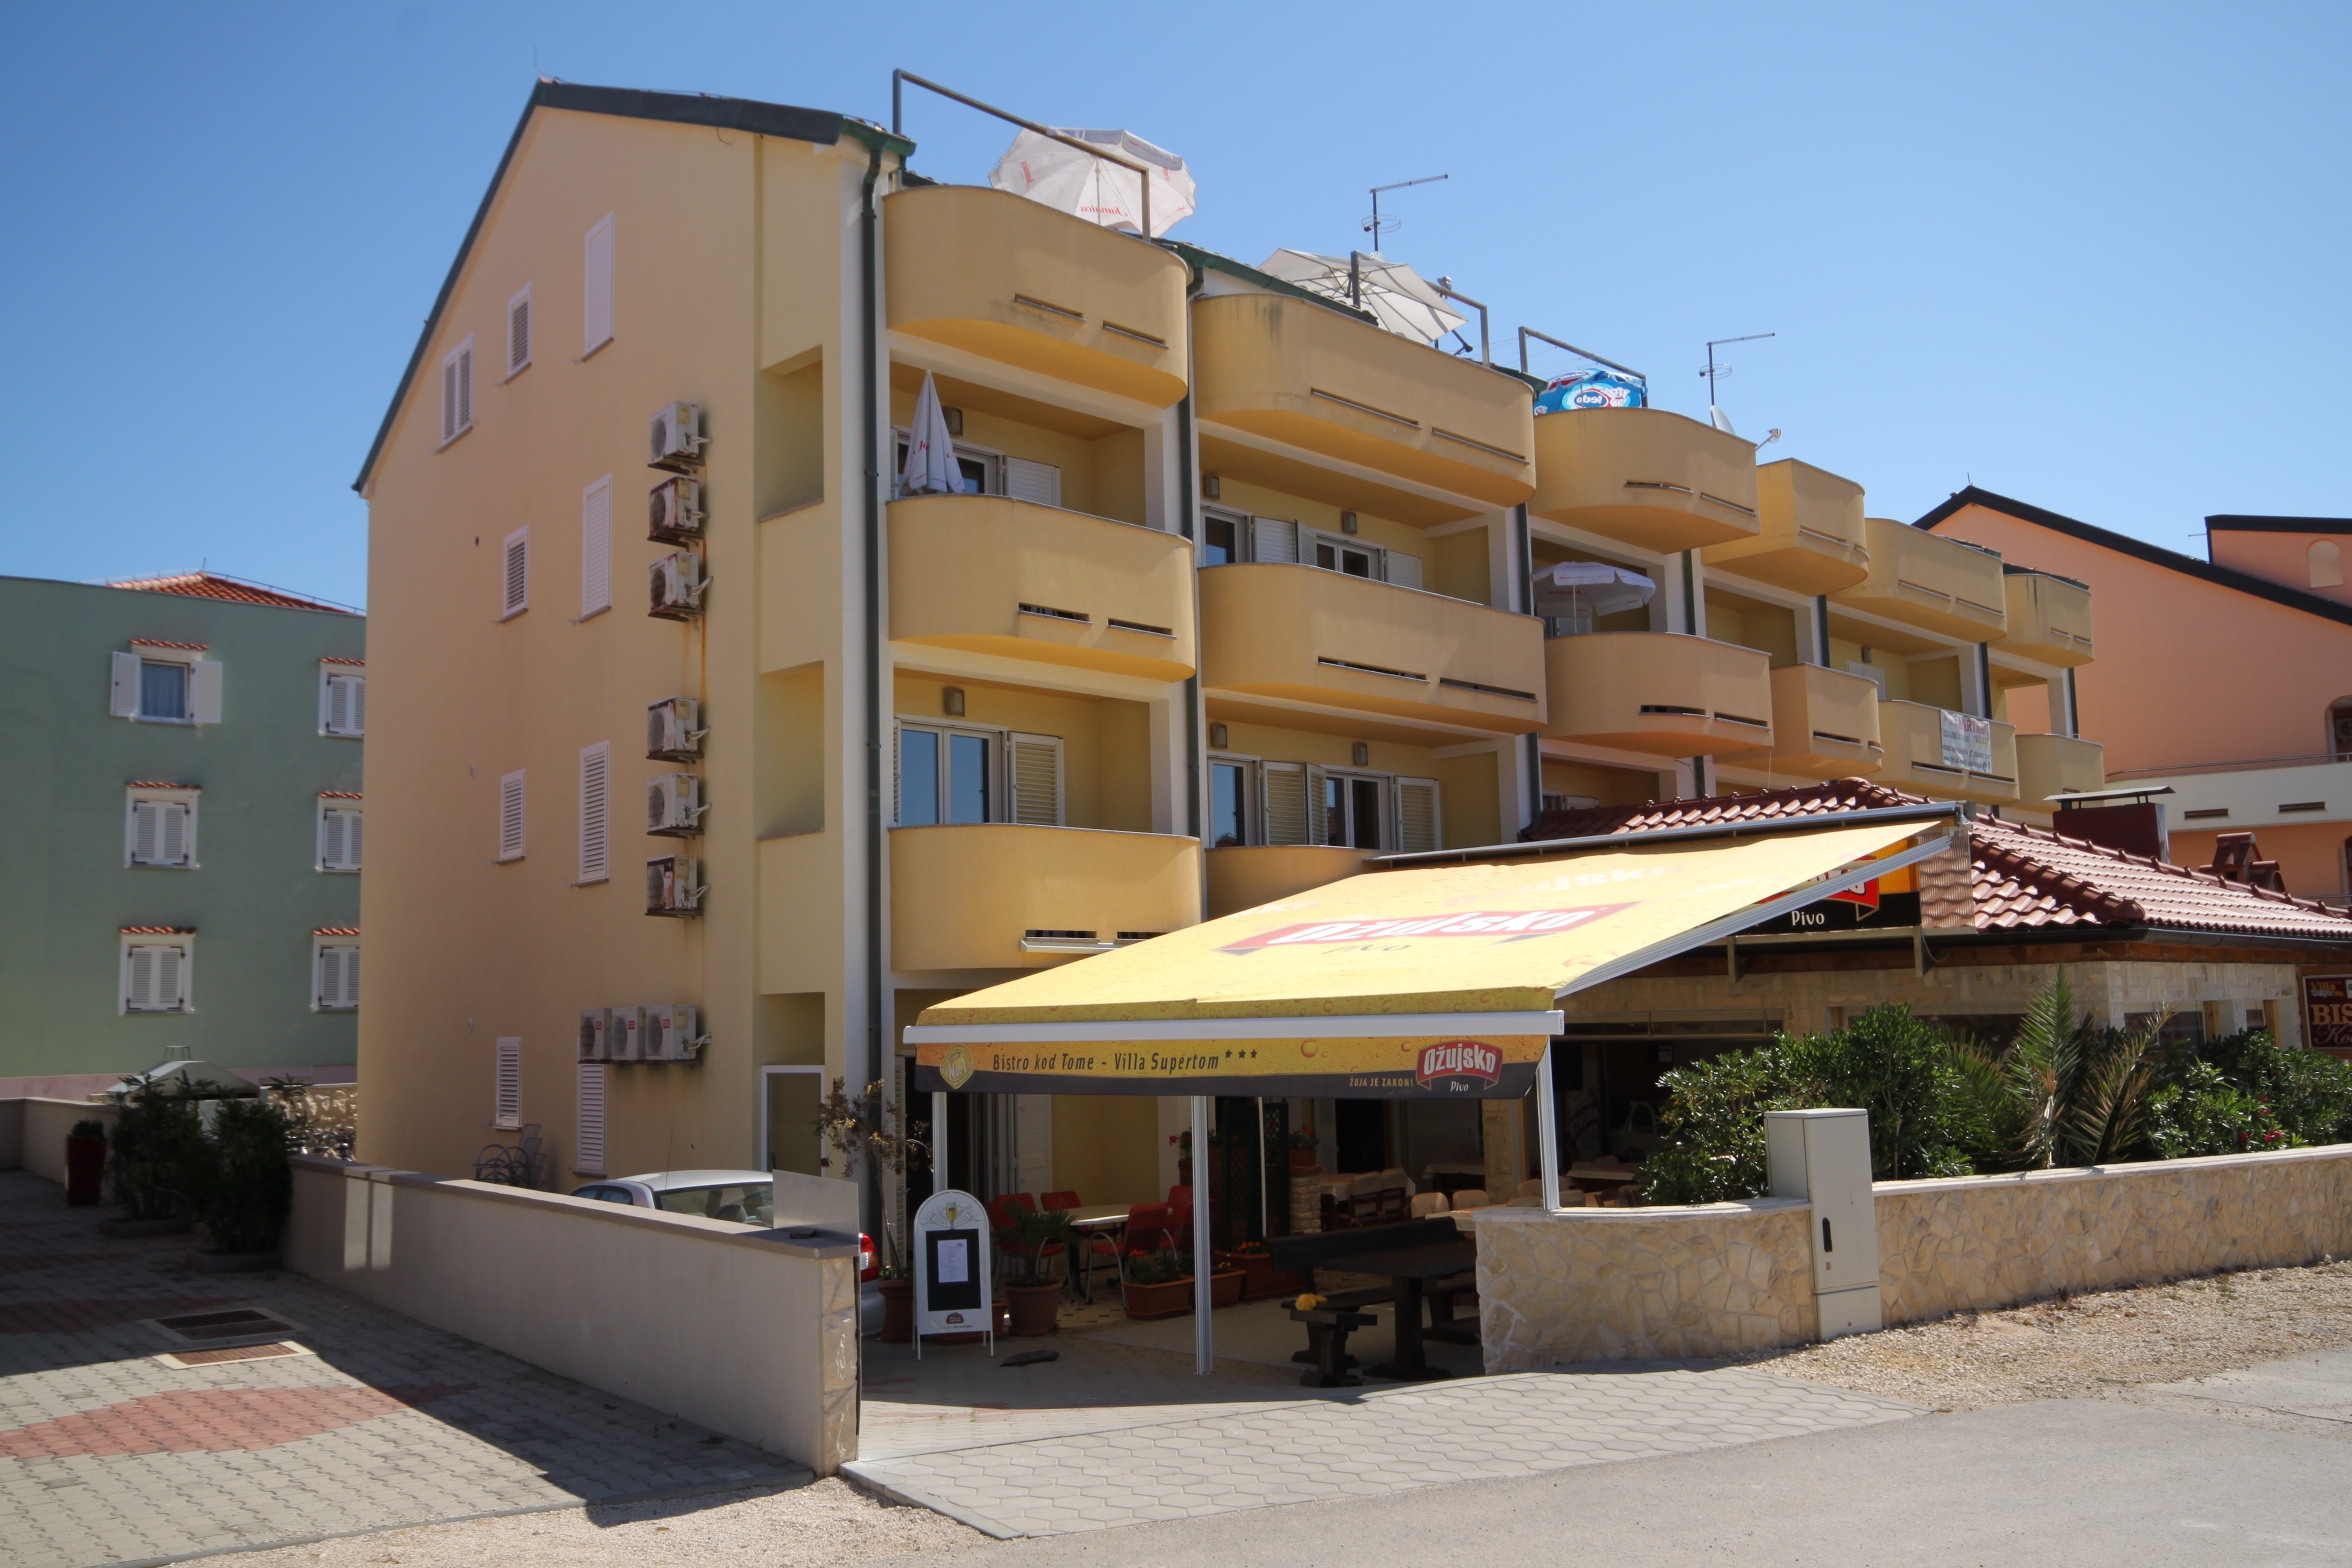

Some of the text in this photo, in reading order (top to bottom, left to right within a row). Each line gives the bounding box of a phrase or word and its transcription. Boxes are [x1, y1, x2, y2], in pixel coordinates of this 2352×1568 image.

[1791, 910, 1825, 926] Pivo
[993, 1054, 1029, 1070] Bistro
[1034, 1054, 1056, 1070] kod
[1061, 1053, 1094, 1070] Tome
[1114, 1053, 1145, 1070] Villa
[1151, 1052, 1219, 1074] Supertom
[1424, 1043, 1496, 1076] Ožujsko
[1349, 1076, 1414, 1087] ŽUJA JE ZAKON!
[1450, 1081, 1469, 1092] Pivo
